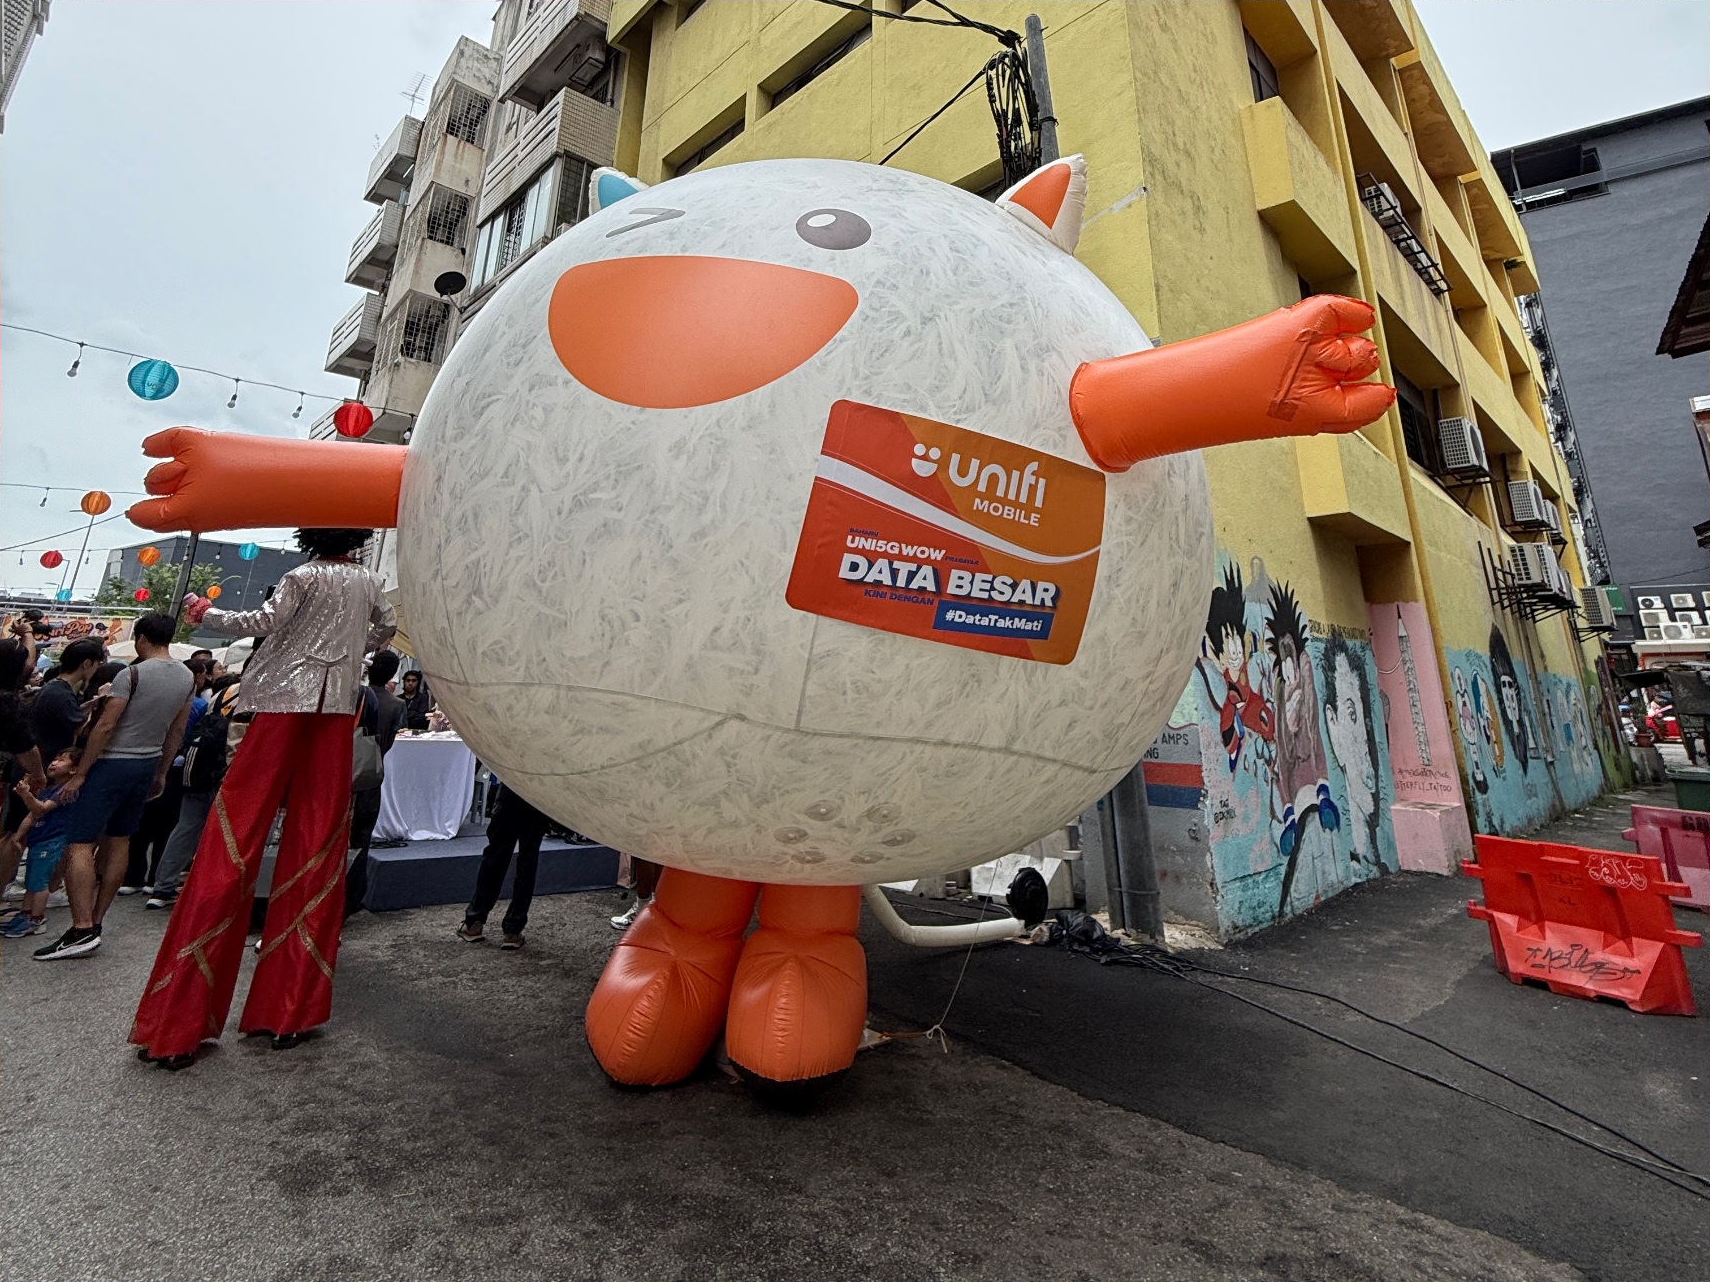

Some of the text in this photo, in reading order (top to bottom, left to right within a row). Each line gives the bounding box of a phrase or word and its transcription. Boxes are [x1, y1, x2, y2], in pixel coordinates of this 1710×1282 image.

[949, 453, 1046, 508] unifi
[973, 498, 1041, 527] MOBILE
[838, 553, 1056, 607] DATA BESAR
[864, 589, 934, 606] KINI DENGAN
[945, 609, 1042, 632] #DataTakMati
